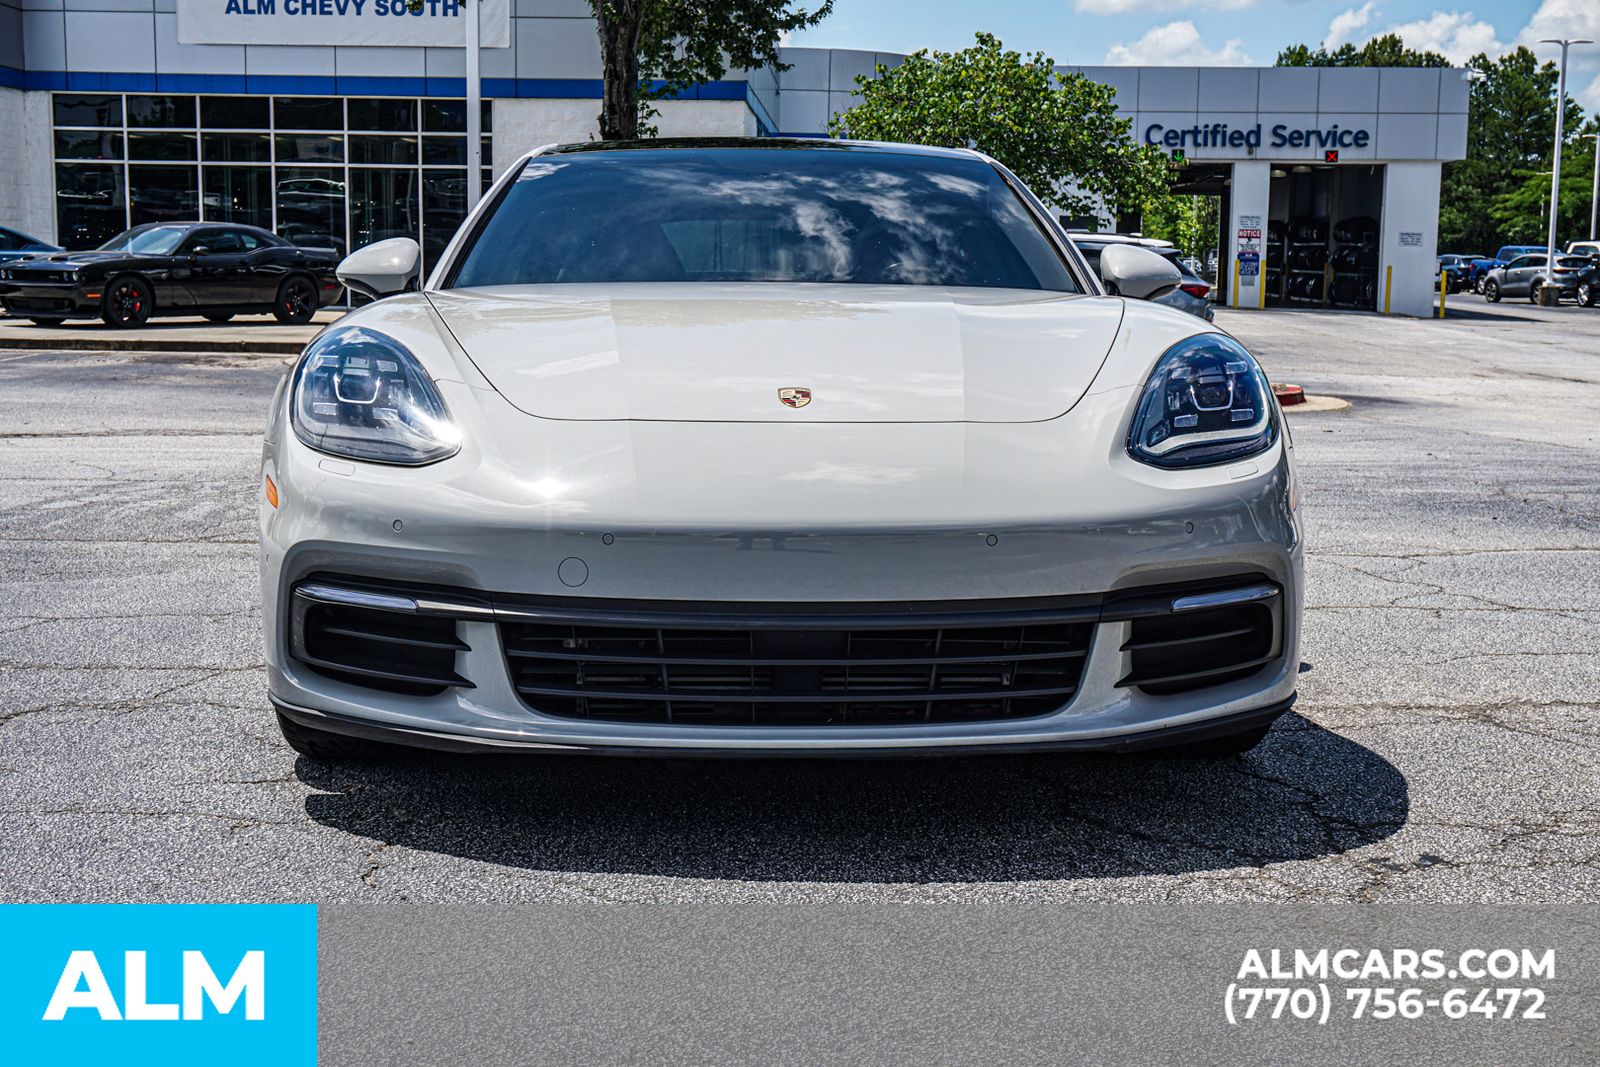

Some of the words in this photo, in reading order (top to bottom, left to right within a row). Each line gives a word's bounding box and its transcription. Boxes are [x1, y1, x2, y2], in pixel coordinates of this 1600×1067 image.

[225, 0, 276, 15] ALM
[284, 0, 364, 16] CHEVY
[1145, 124, 1262, 148] Certified
[1271, 124, 1369, 148] Service
